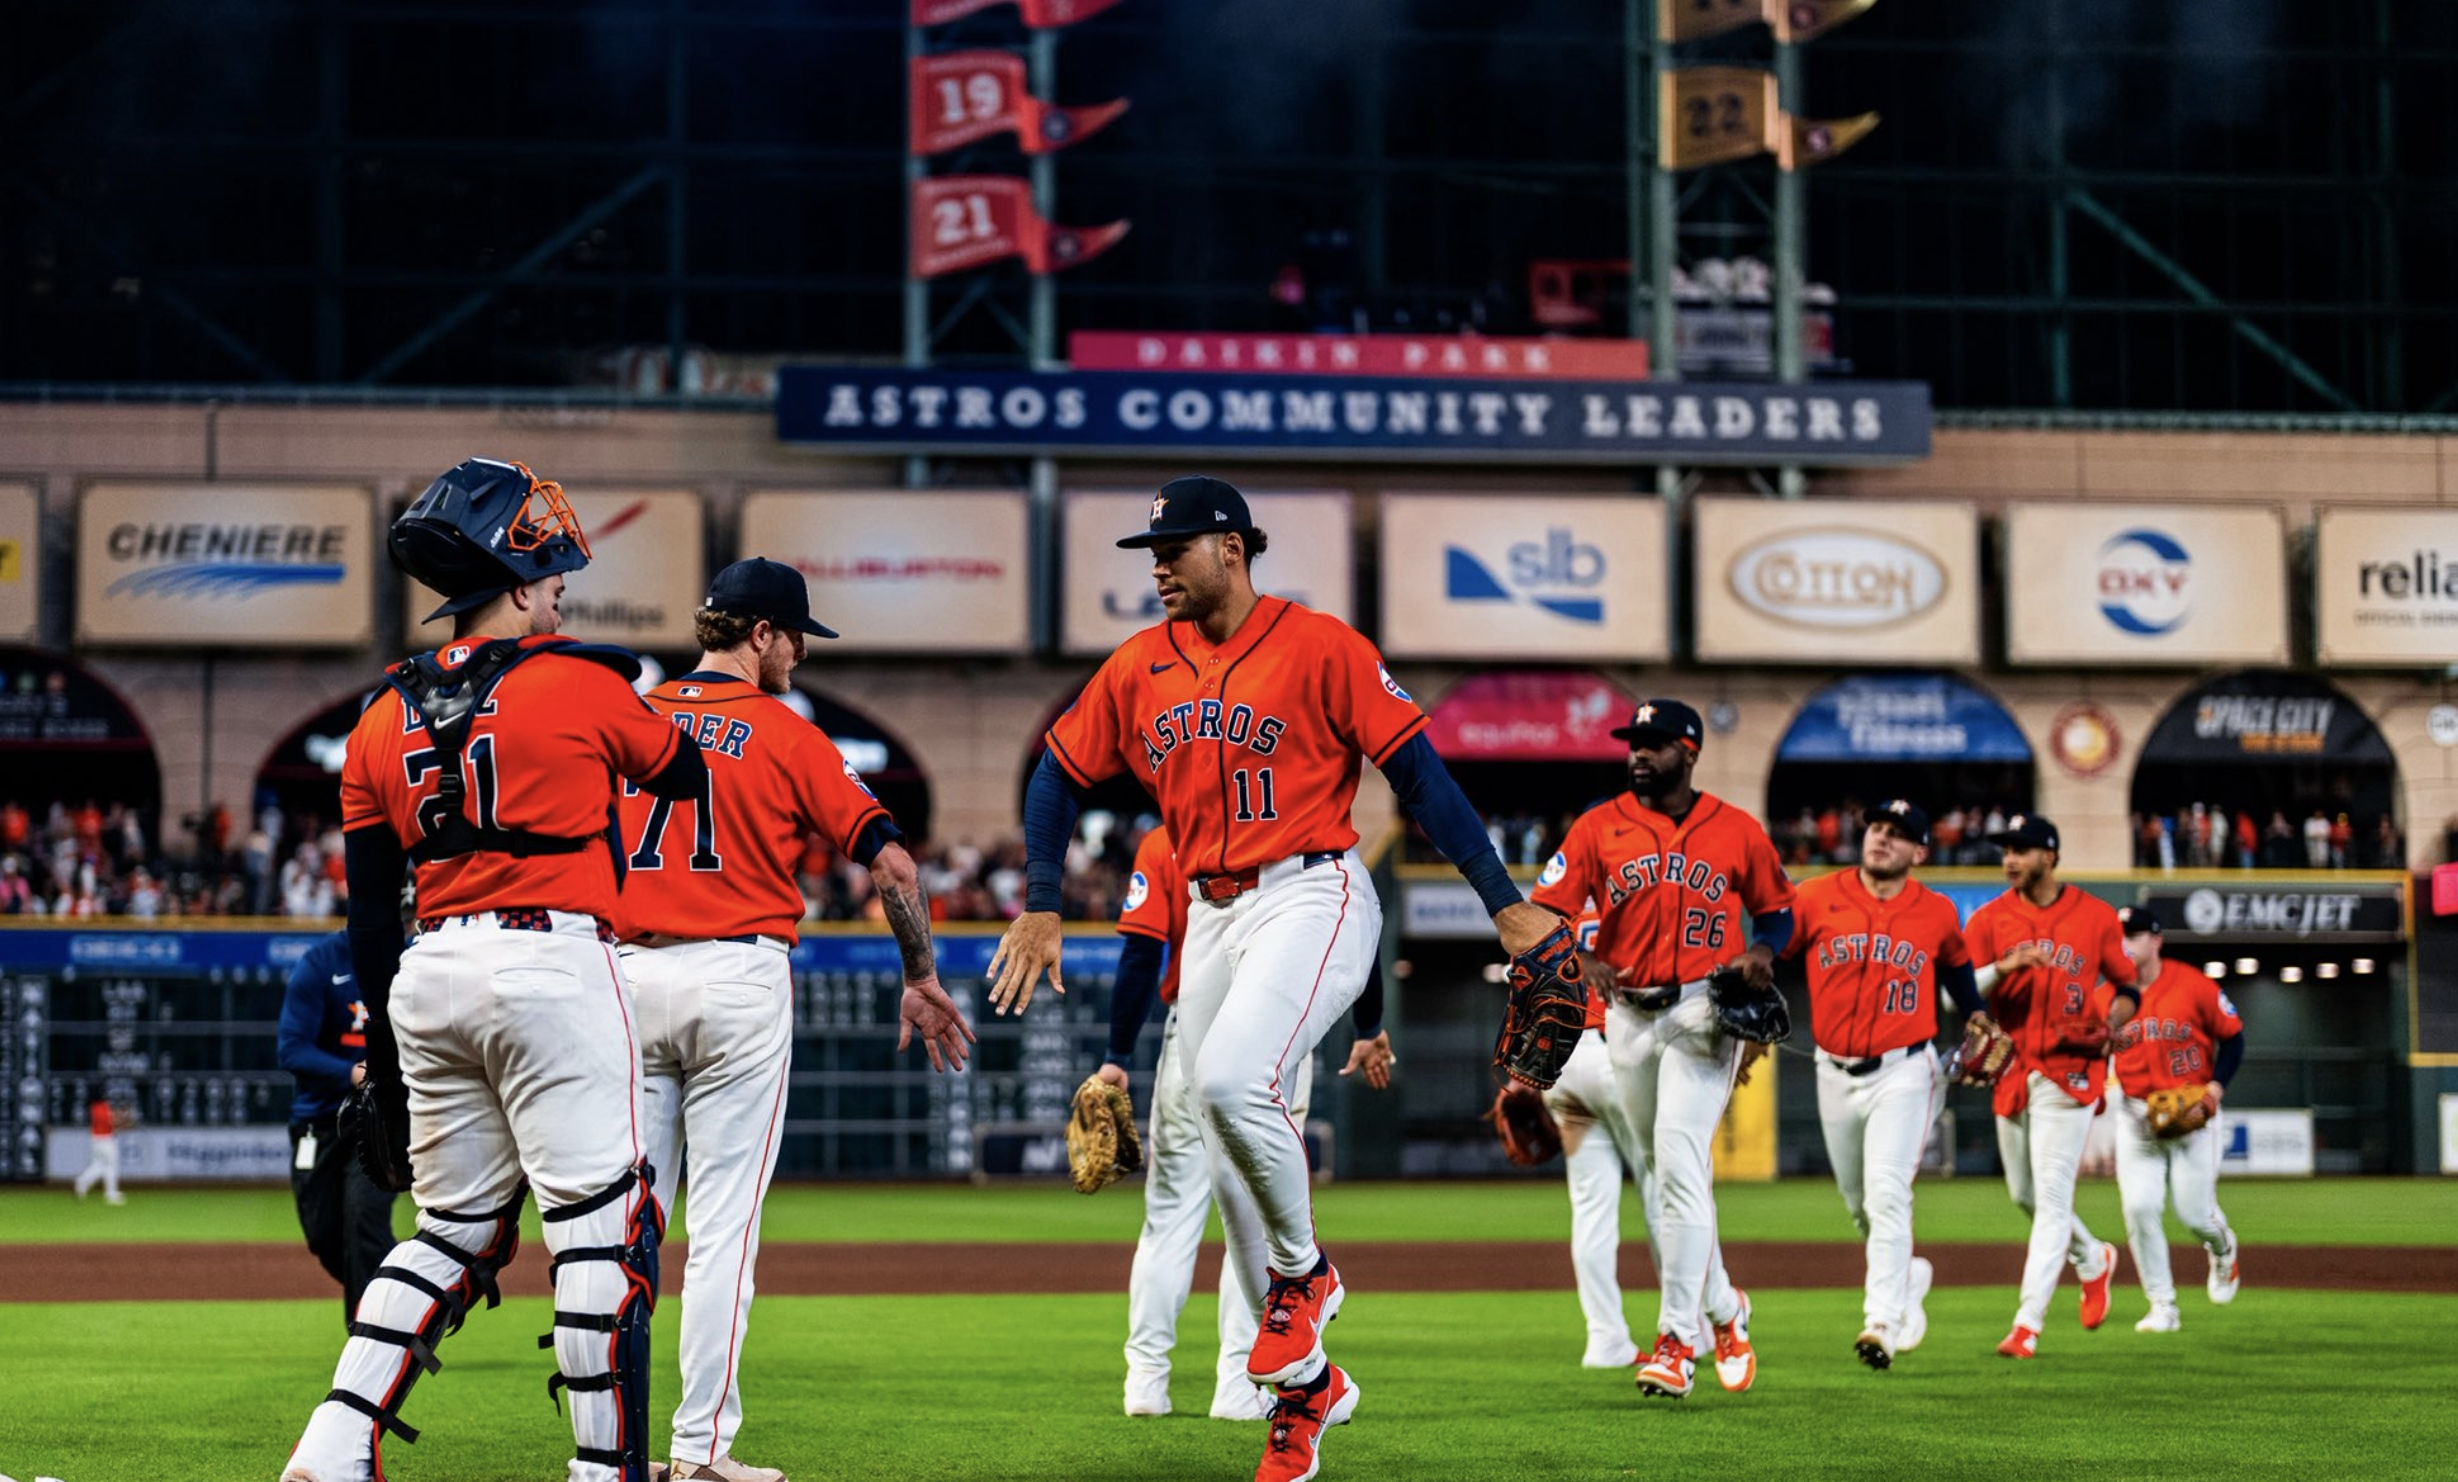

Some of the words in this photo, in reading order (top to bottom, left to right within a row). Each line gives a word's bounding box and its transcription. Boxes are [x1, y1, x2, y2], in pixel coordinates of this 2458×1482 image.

[935, 73, 1003, 123] 19
[1686, 92, 1749, 137] 22
[933, 194, 998, 244] 21
[1137, 337, 1358, 368] DAIKIN
[1404, 342, 1552, 371] PARK
[825, 385, 1086, 428] ASTROS
[1117, 389, 1553, 436] COMMUNITY
[1582, 396, 1883, 441] LEADERS
[108, 523, 348, 562] CHENIERE
[1508, 528, 1607, 588] slb
[2098, 568, 2189, 599] OXY
[672, 711, 753, 760] DER
[1142, 698, 1287, 774] ASTROS
[1233, 768, 1278, 822] 11
[1605, 851, 1728, 908] ASTROS
[1683, 907, 1727, 951] 26
[2225, 893, 2362, 939] EMCJET
[1818, 932, 1928, 973] ASTROS
[1883, 979, 1918, 1016] 18
[2064, 982, 2084, 1016] 3
[2168, 1045, 2202, 1078] 20
